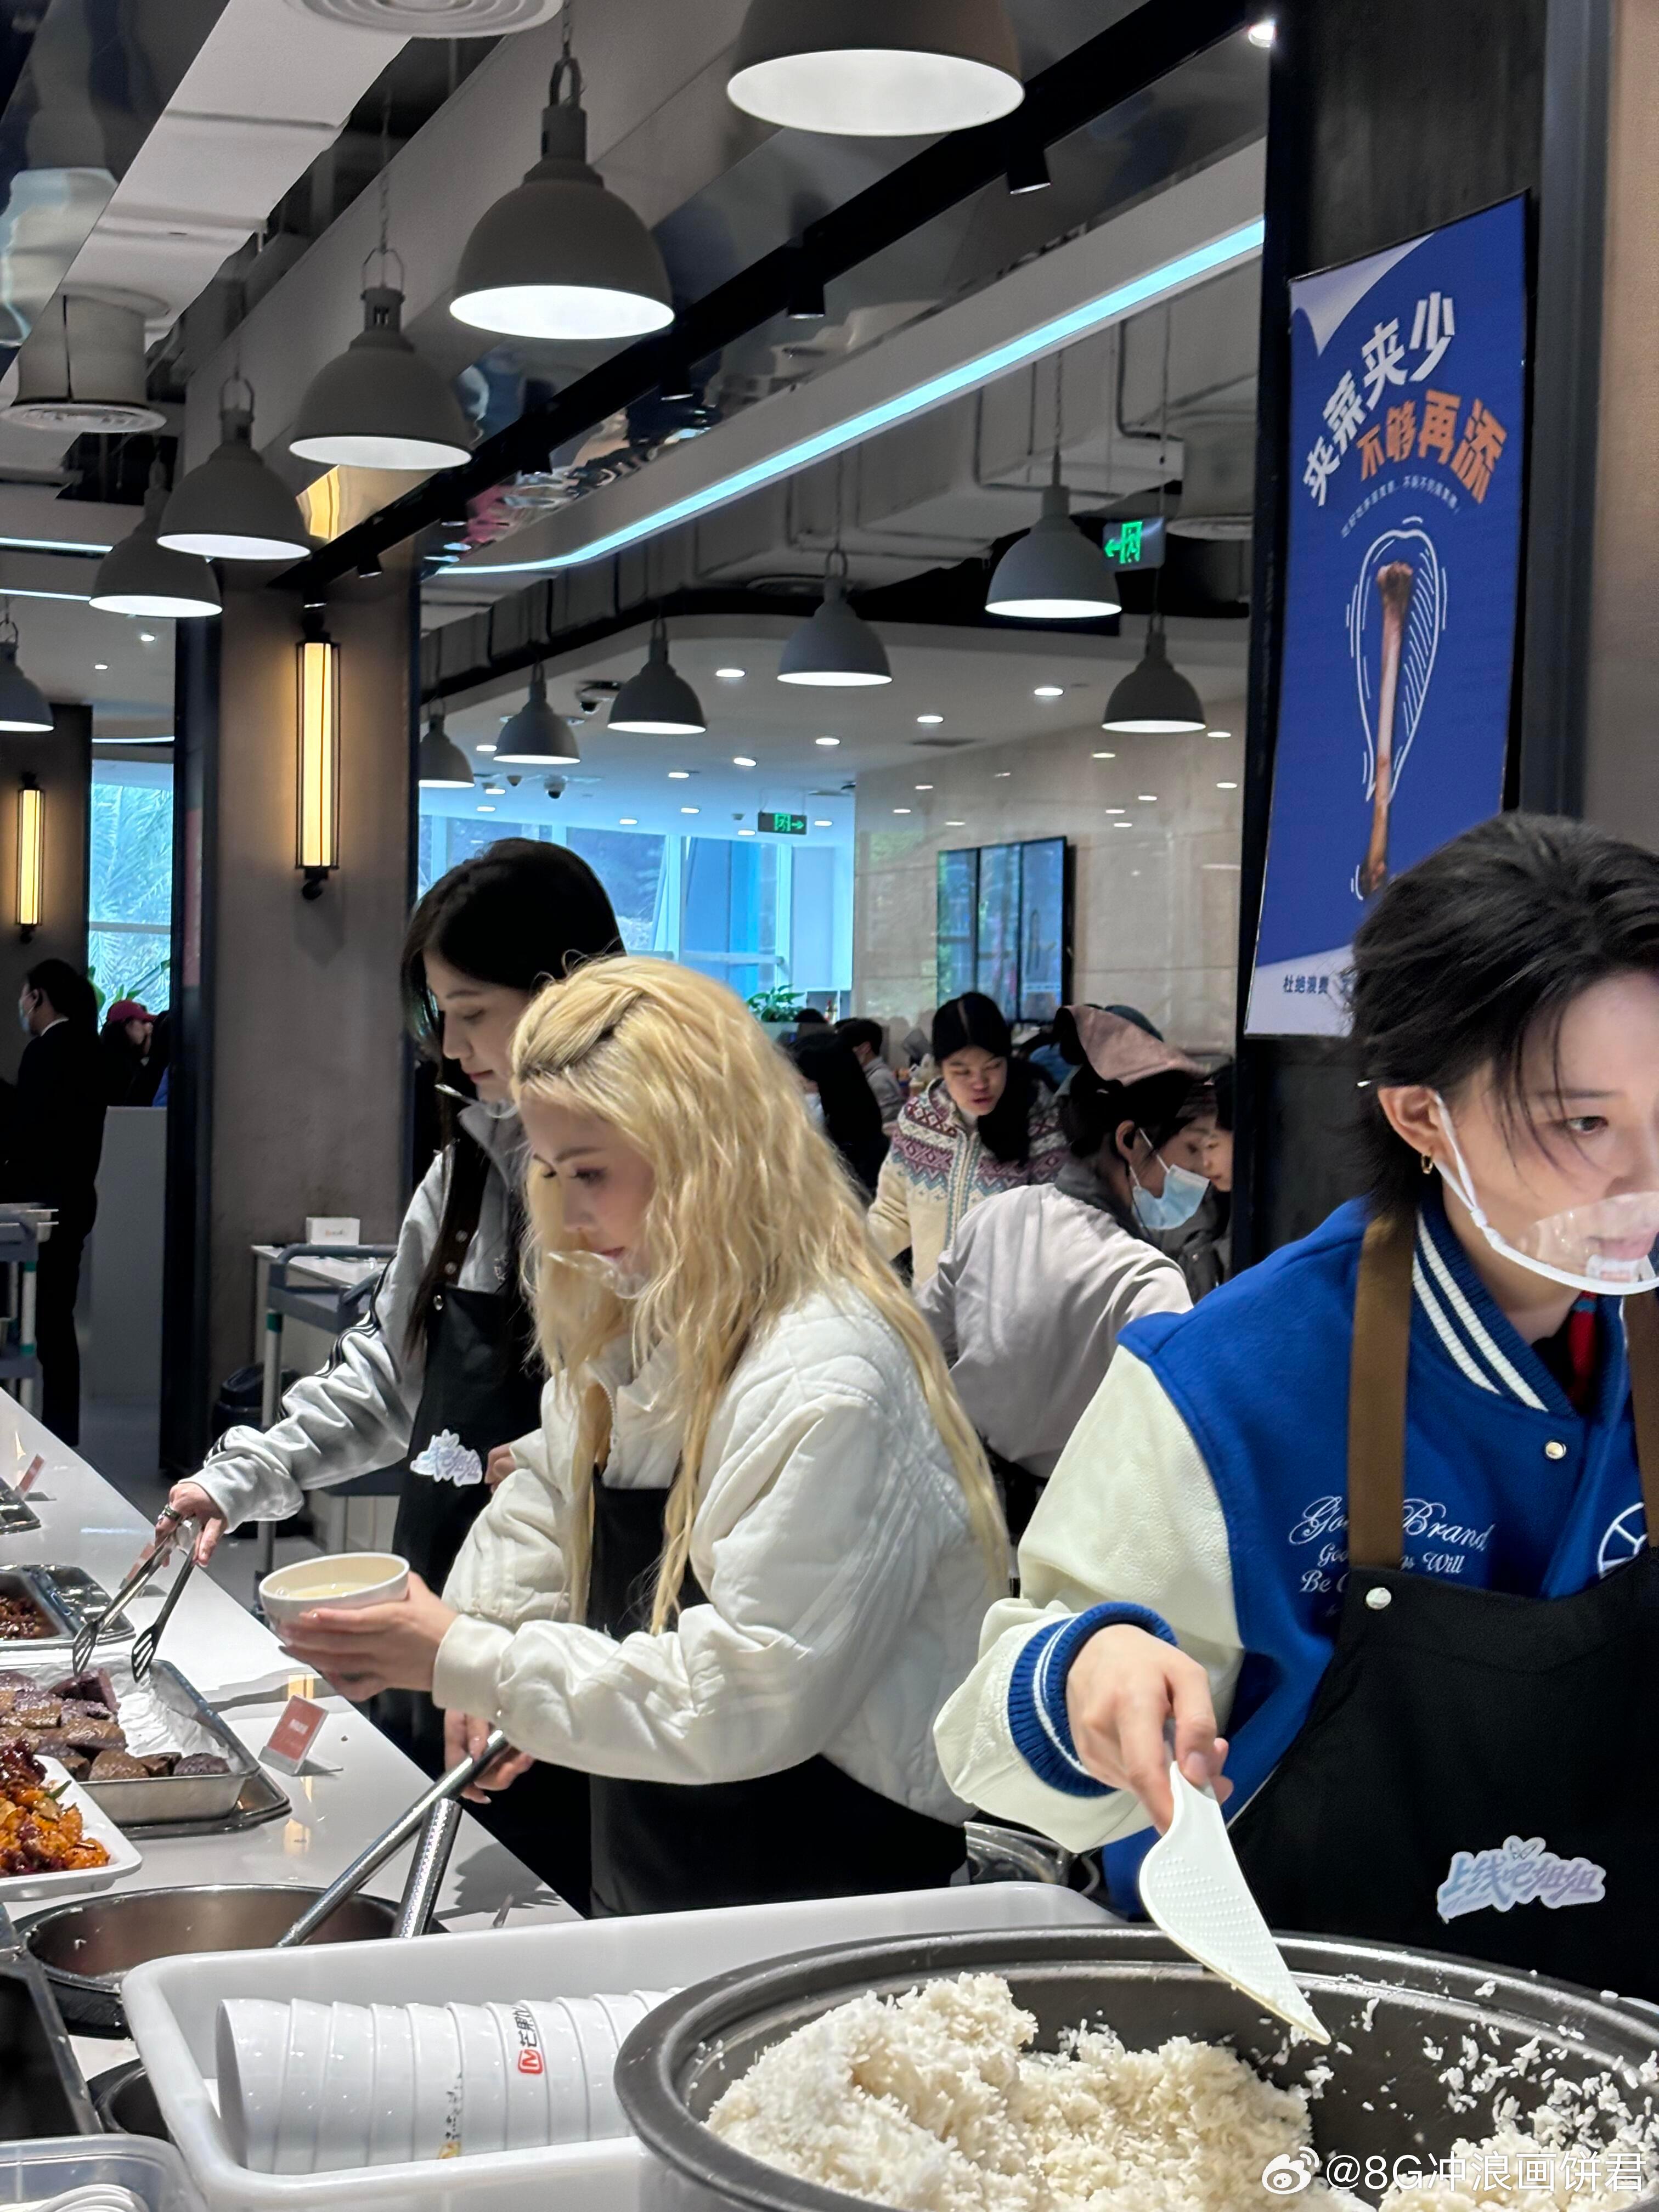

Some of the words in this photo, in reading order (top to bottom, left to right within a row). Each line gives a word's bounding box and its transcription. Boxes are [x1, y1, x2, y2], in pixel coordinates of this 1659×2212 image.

[1356, 388, 1507, 505] 不够再添
[1402, 1498, 1496, 1552] Brand
[1299, 1570, 1332, 1593] Be
[1423, 1551, 1465, 1574] Will
